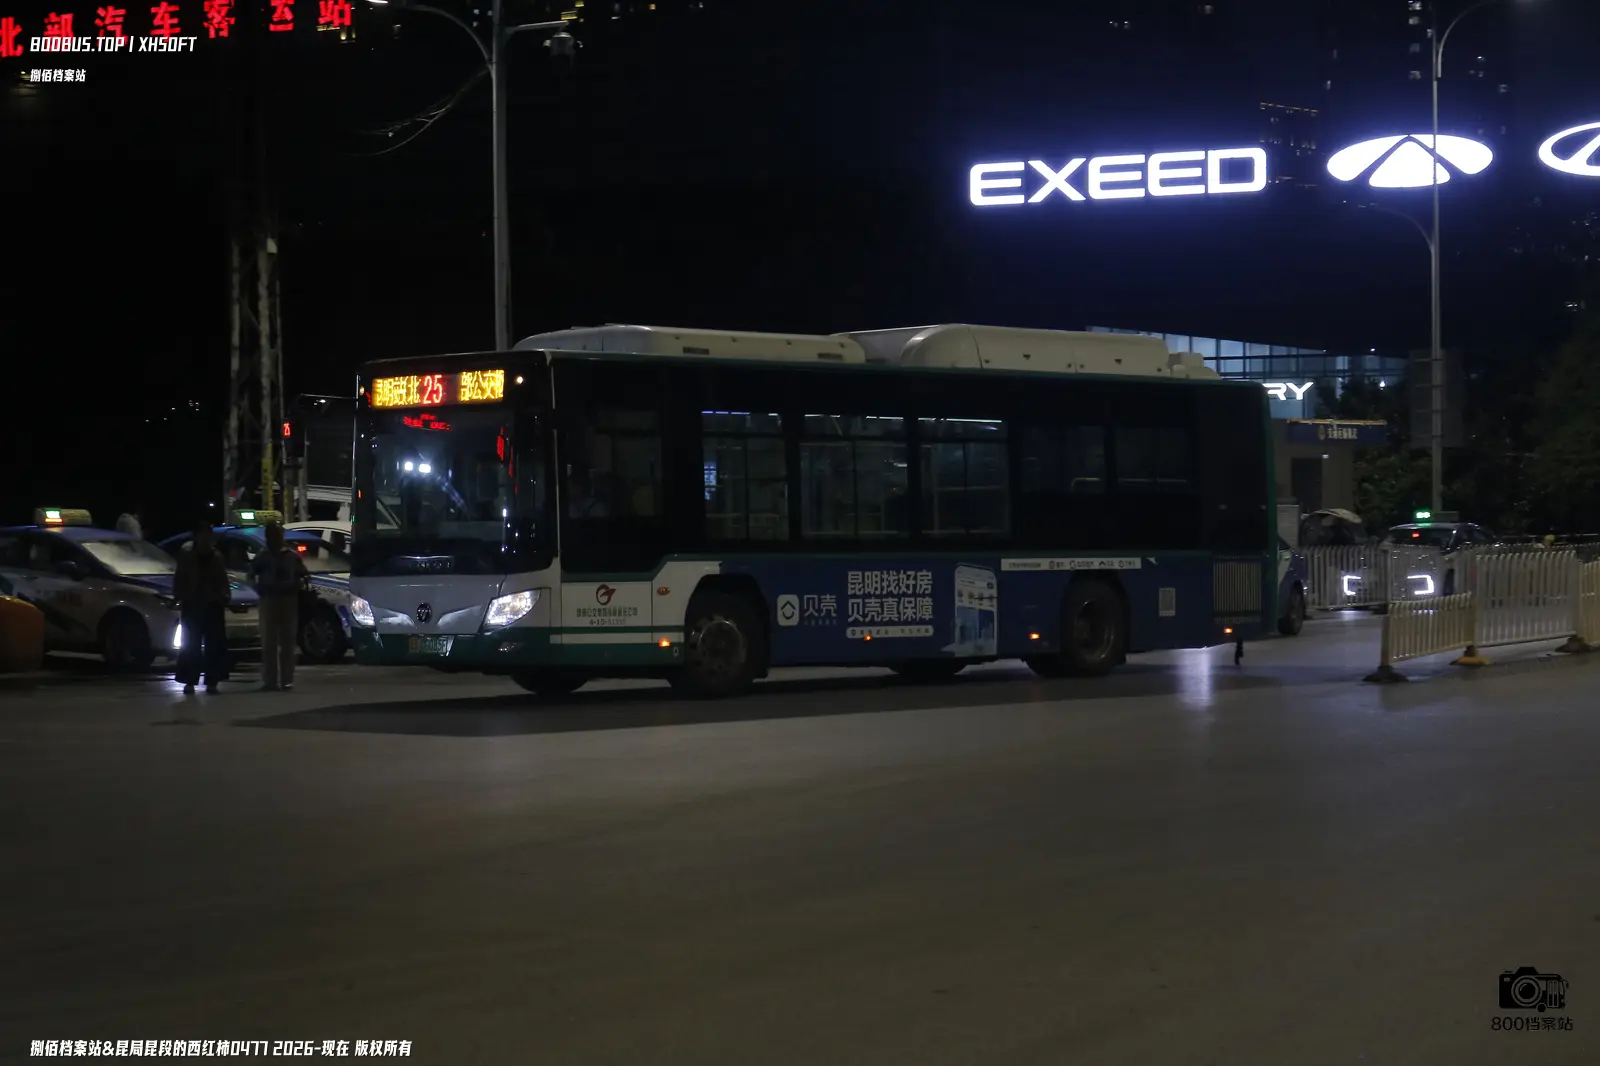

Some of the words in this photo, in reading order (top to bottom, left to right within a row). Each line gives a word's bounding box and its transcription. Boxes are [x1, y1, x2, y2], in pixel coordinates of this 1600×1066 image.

[969, 147, 1267, 206] EXEED
[423, 375, 443, 404] 25
[847, 570, 933, 595] 昆明找好房
[804, 594, 837, 617] 贝壳
[848, 597, 934, 622] 贝壳真保障
